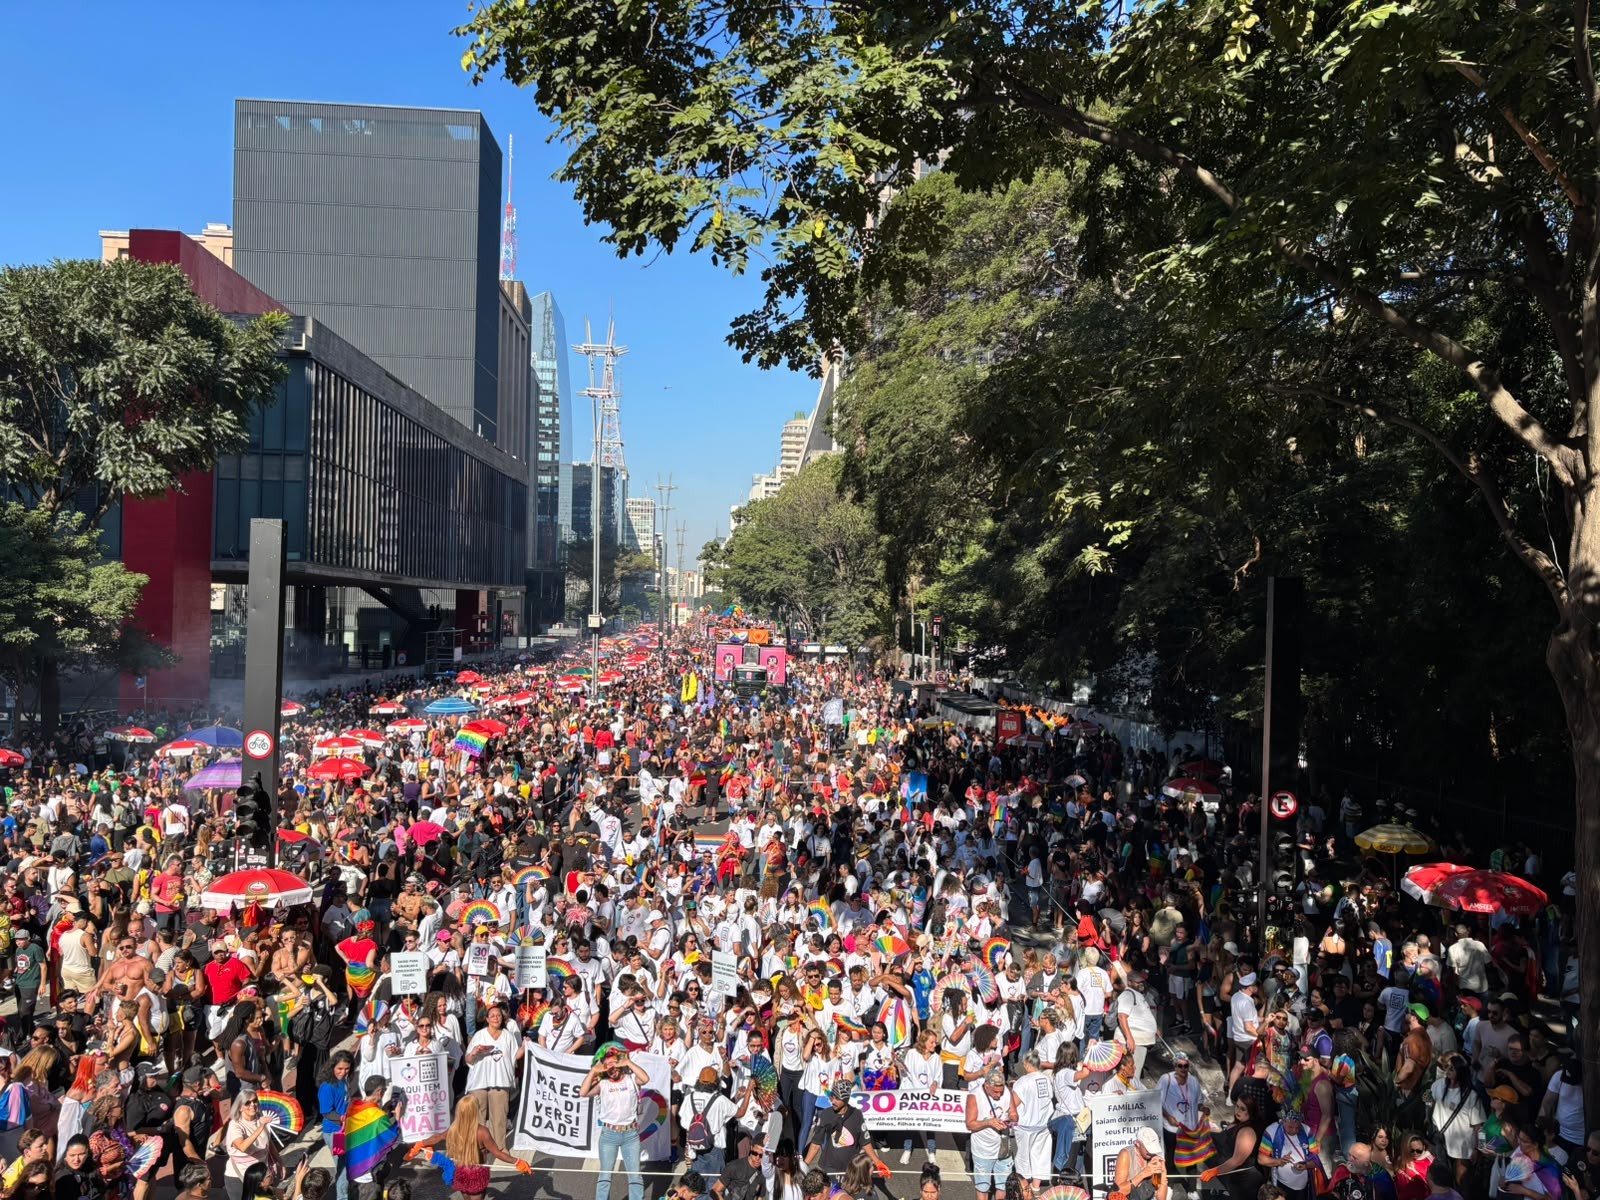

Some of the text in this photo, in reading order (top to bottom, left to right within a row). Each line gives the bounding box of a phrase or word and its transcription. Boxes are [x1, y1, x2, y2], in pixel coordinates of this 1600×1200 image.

[1469, 902, 1494, 911] AMSTEL
[474, 946, 487, 957] 30
[424, 1083, 440, 1091] TEM
[536, 1070, 581, 1098] MÃES
[407, 1089, 447, 1105] BRAÇO
[536, 1089, 580, 1113] PELA DI
[851, 1092, 896, 1113] 30
[899, 1092, 961, 1103] ANOS DE
[534, 1100, 580, 1126] VERSI
[899, 1102, 964, 1114] PARADA
[1108, 1102, 1146, 1112] FAMÍLIAS,
[401, 1112, 447, 1132] MÃE
[531, 1114, 579, 1138] DADE
[1095, 1117, 1116, 1125] saiam
[1094, 1139, 1126, 1148] precisam
